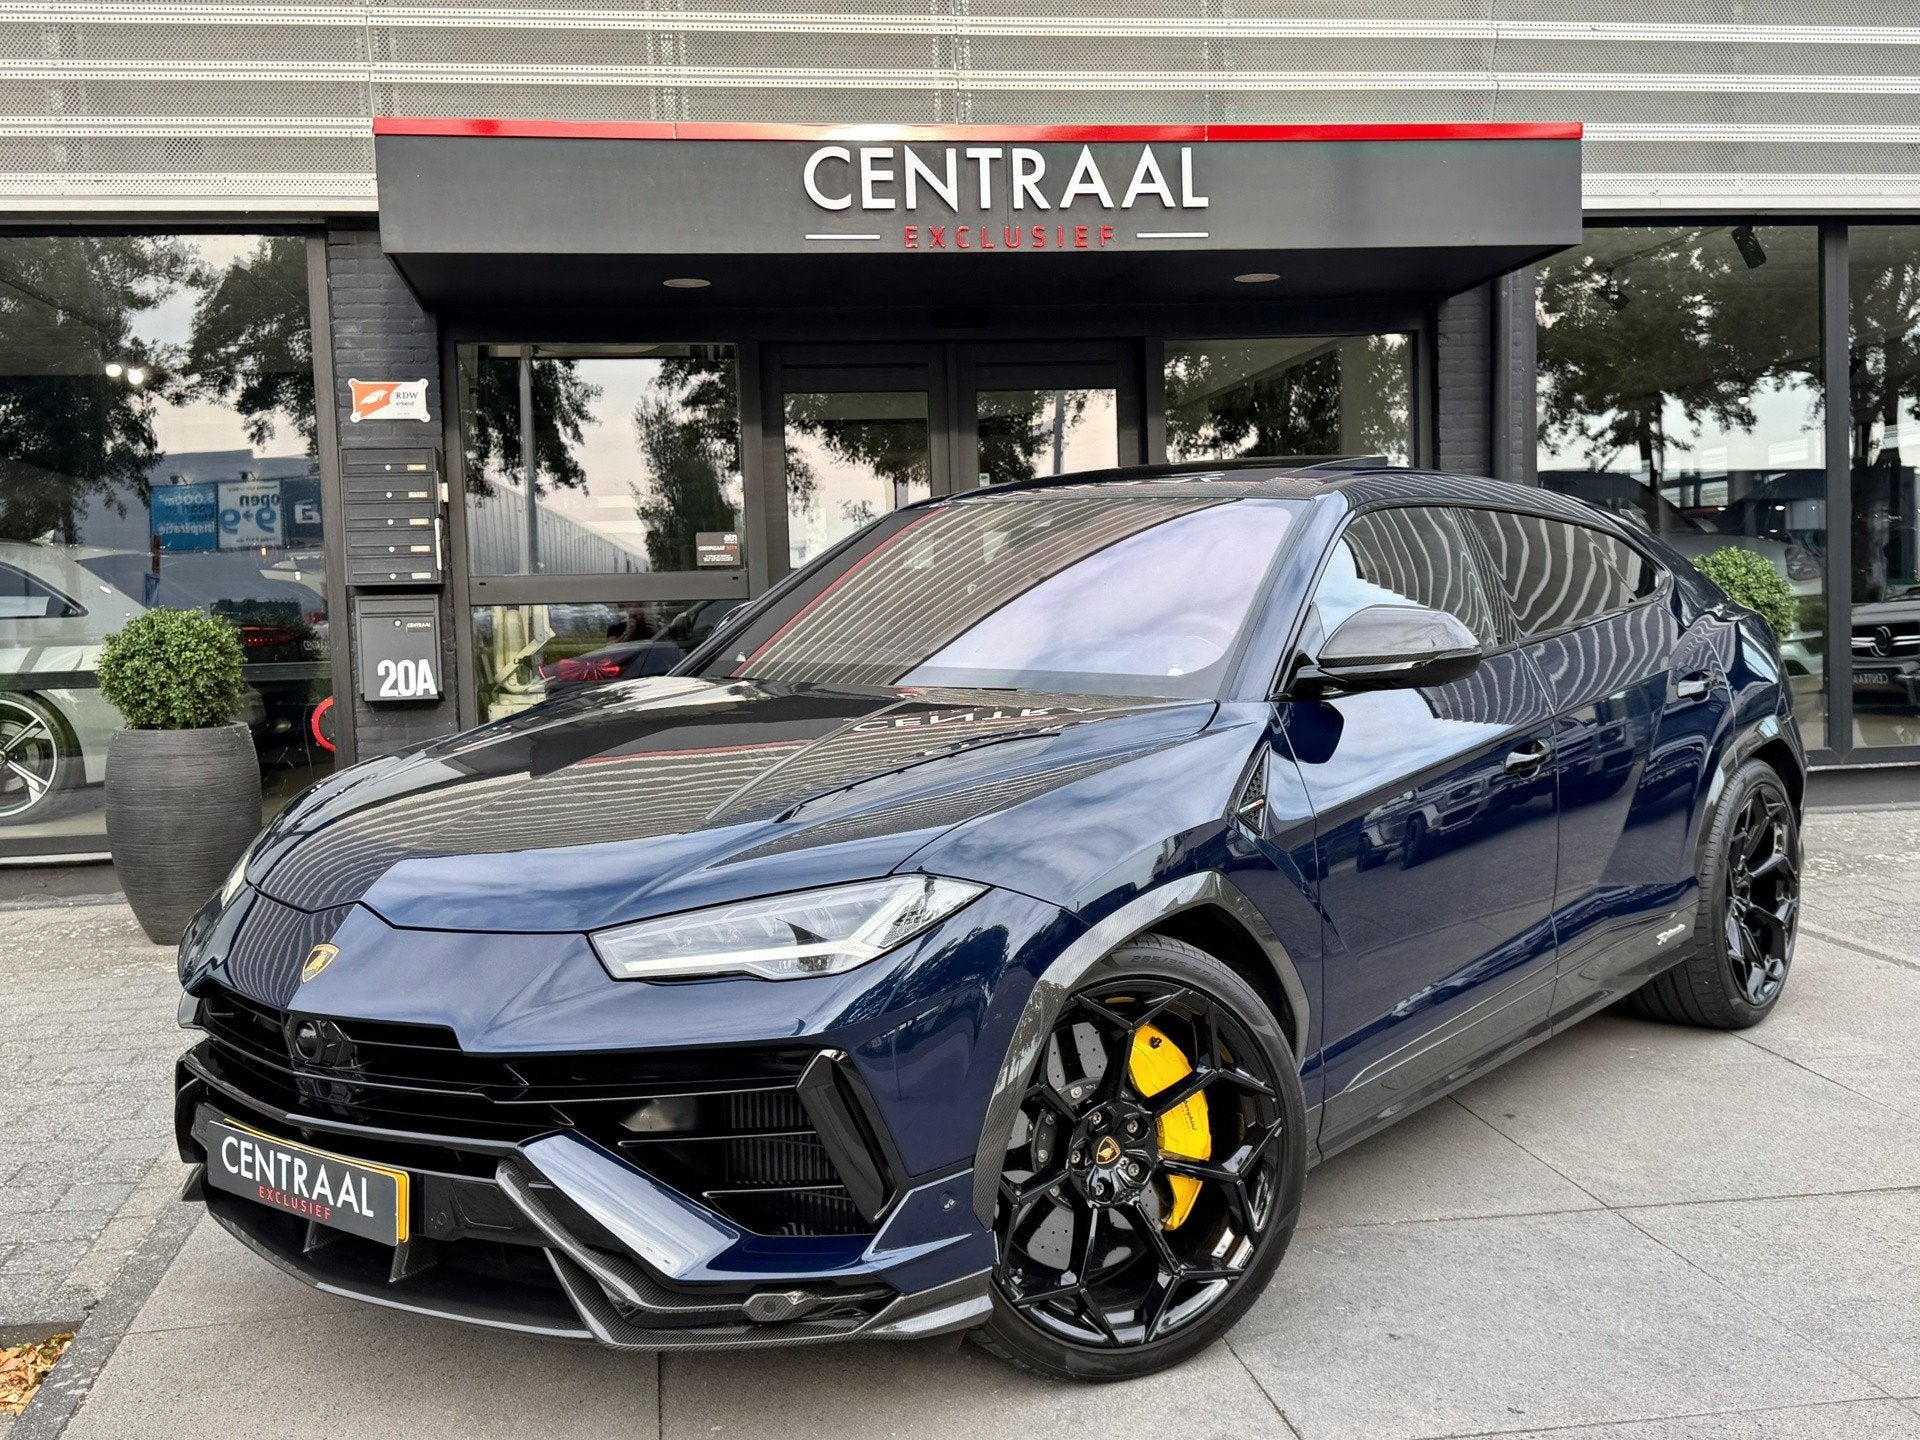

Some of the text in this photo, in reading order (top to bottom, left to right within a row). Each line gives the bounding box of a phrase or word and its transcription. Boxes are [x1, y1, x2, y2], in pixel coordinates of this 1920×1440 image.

[803, 144, 1209, 212] CENTRAAL
[904, 226, 1116, 249] EXCLUSIEF
[377, 659, 437, 697] 20A
[221, 1136, 375, 1217] CENTRAAL
[258, 1186, 332, 1220] EXCLUSIEF
